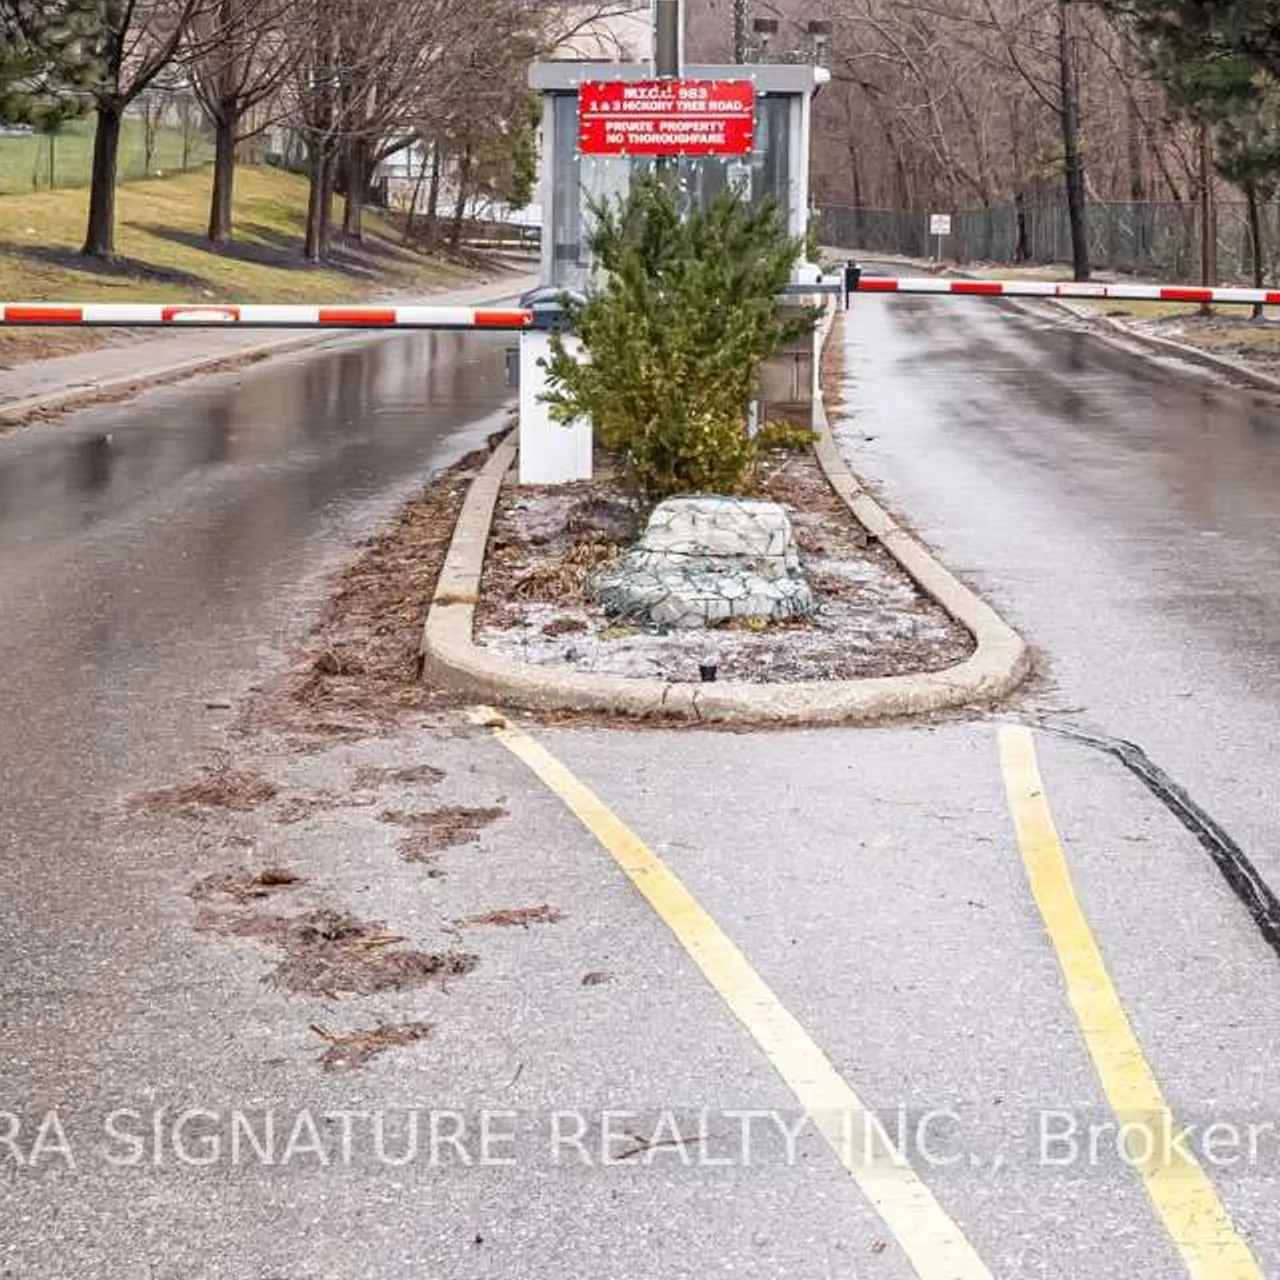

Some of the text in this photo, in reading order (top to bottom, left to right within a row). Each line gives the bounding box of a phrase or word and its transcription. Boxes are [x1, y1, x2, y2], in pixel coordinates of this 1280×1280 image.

[623, 100, 675, 111] HICKORY
[676, 100, 707, 111] TREE
[708, 100, 744, 111] ROAD
[605, 120, 726, 132] PRIVATE PROPERTY
[606, 132, 726, 144] NO THOROUGHFARE
